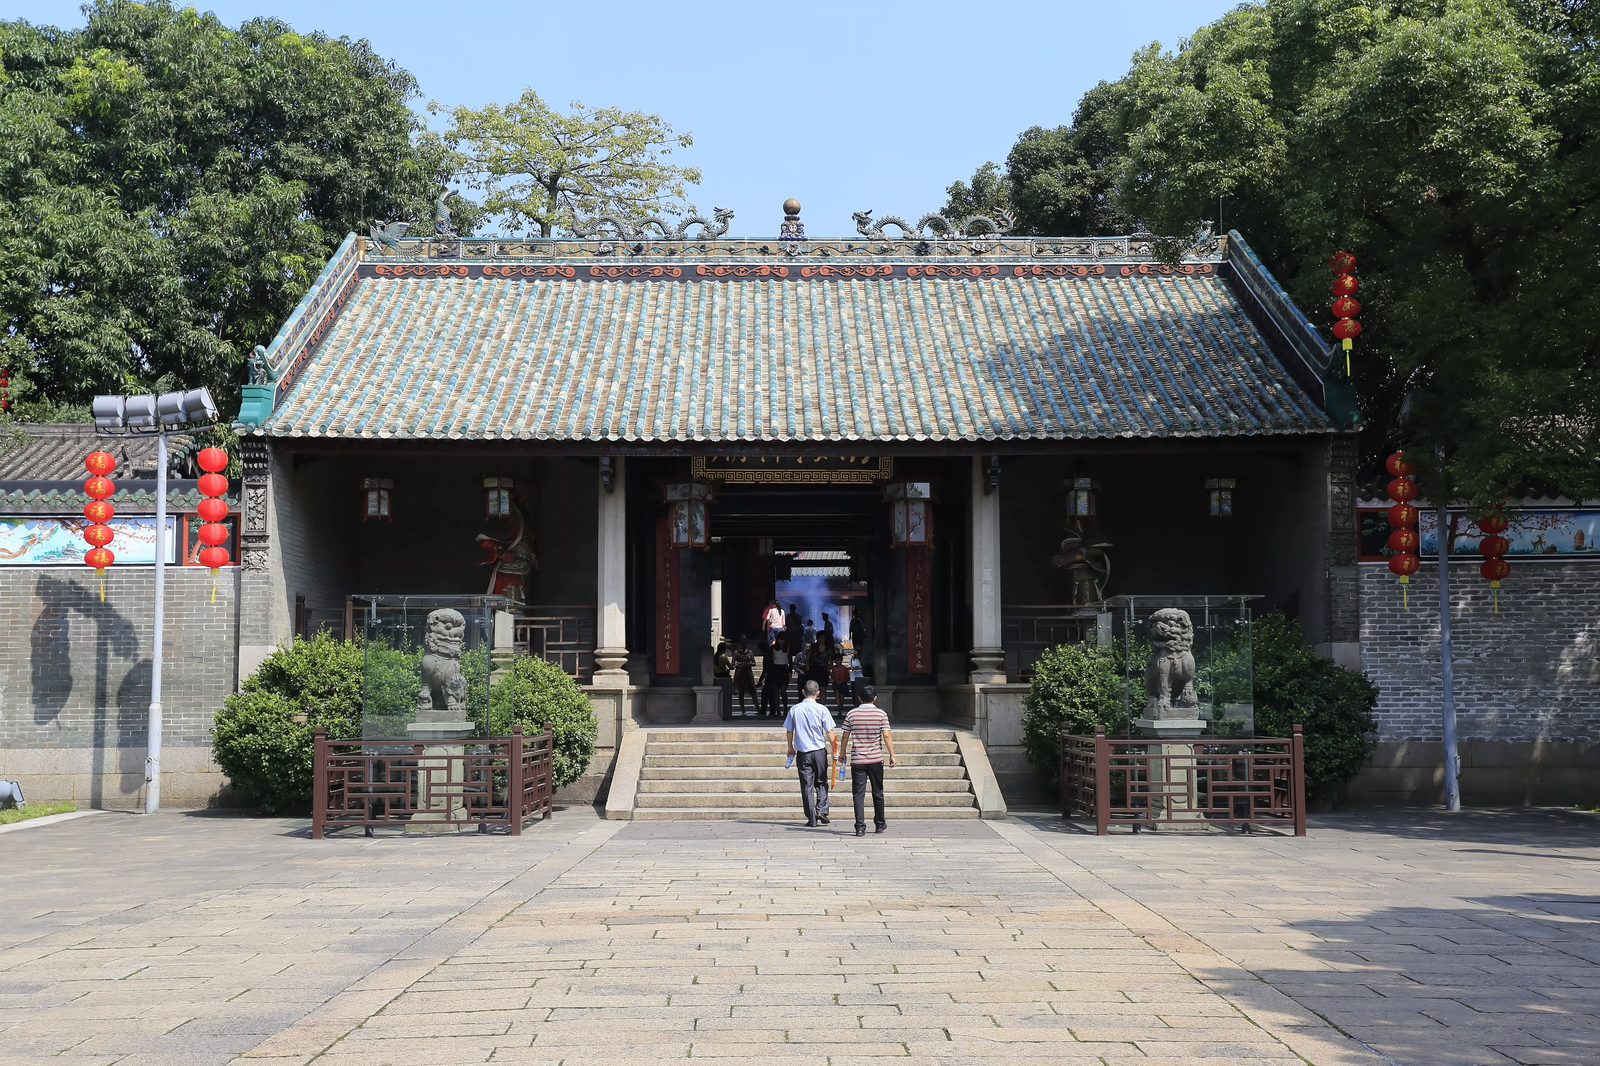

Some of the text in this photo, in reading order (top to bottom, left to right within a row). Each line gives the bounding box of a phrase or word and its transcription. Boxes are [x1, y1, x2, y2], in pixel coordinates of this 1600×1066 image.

[90, 505, 105, 519] 福
[90, 528, 106, 541] 福
[93, 551, 110, 564] 福
